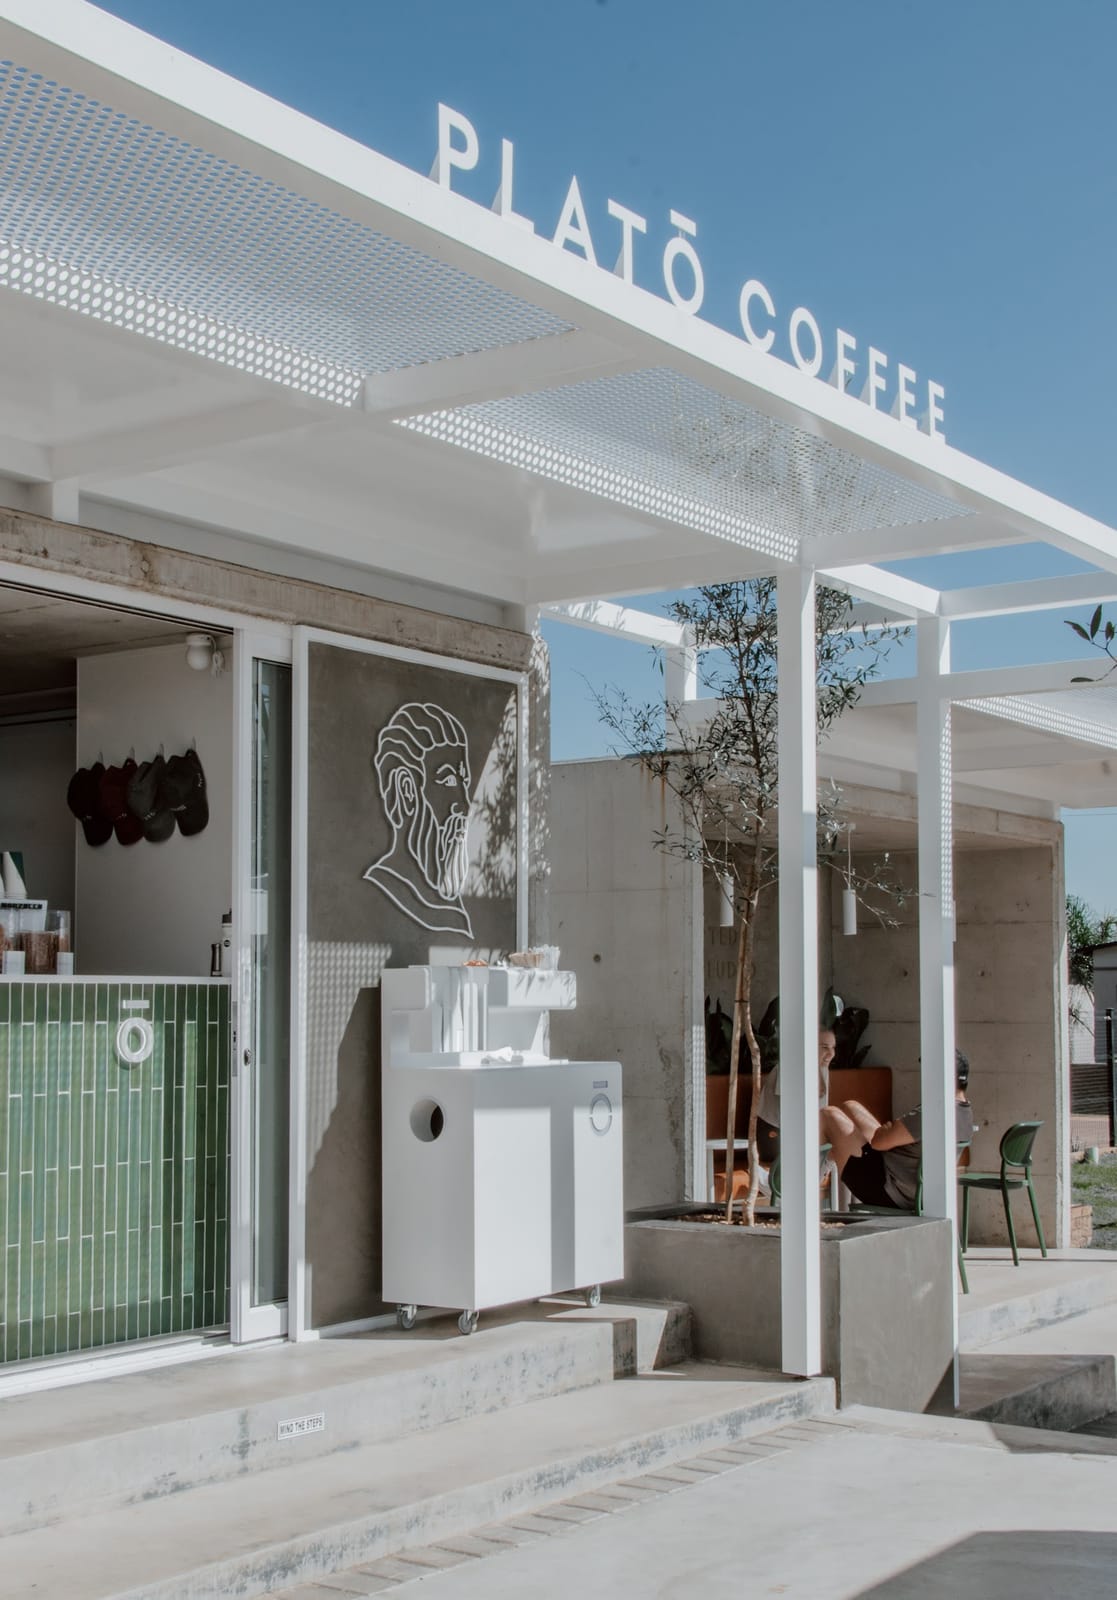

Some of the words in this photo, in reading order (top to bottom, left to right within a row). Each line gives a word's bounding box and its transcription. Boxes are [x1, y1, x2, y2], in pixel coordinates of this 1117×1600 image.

[740, 279, 946, 445] COFFEE
[280, 1423, 294, 1434] MIND
[295, 1420, 305, 1432] THE
[306, 1416, 323, 1430] STEPS
